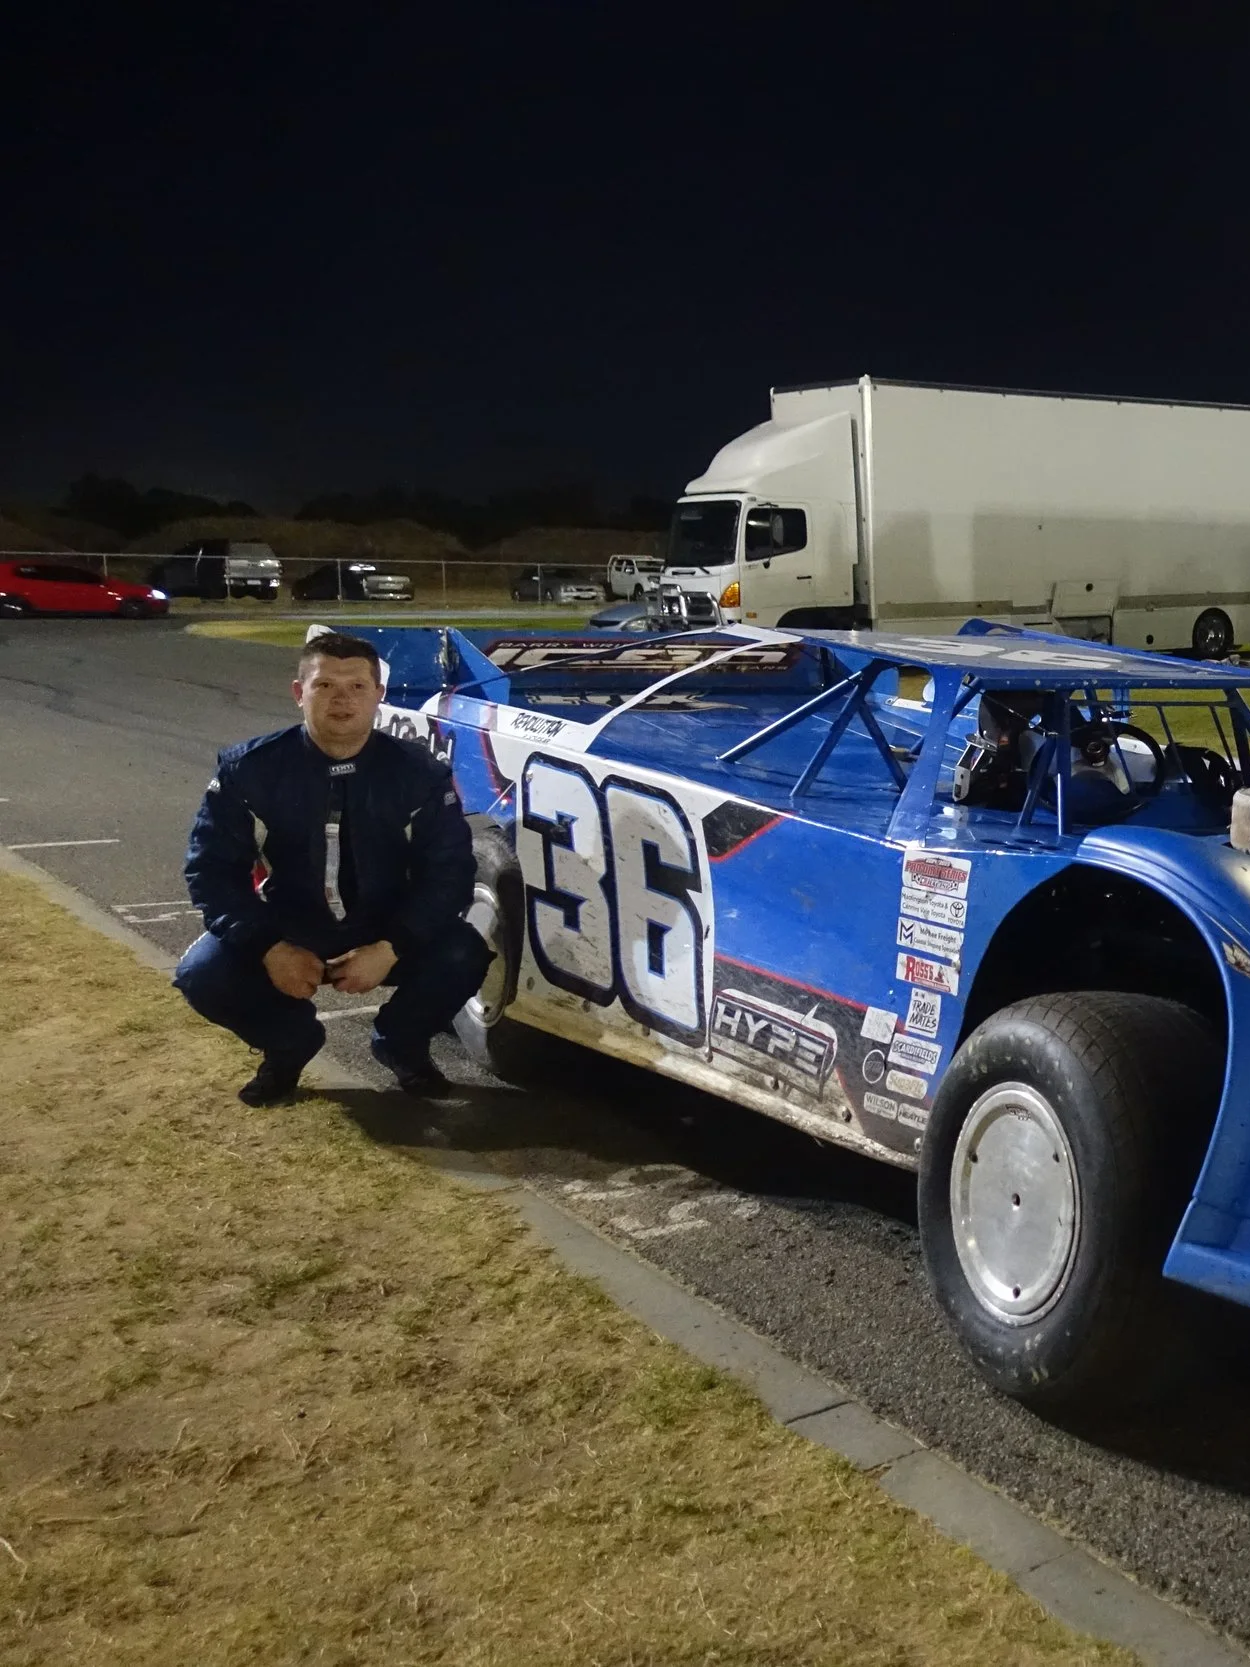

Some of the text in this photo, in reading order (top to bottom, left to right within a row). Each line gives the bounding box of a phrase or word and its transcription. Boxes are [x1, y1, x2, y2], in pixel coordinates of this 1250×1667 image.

[510, 712, 568, 738] REVOLUTION
[522, 751, 706, 1048] 36
[947, 917, 963, 926] TOYOTA
[912, 1000, 936, 1016] TRADE
[909, 1012, 937, 1028] MATES
[714, 1001, 826, 1076] HYPE
[866, 1093, 896, 1111] WILSON
